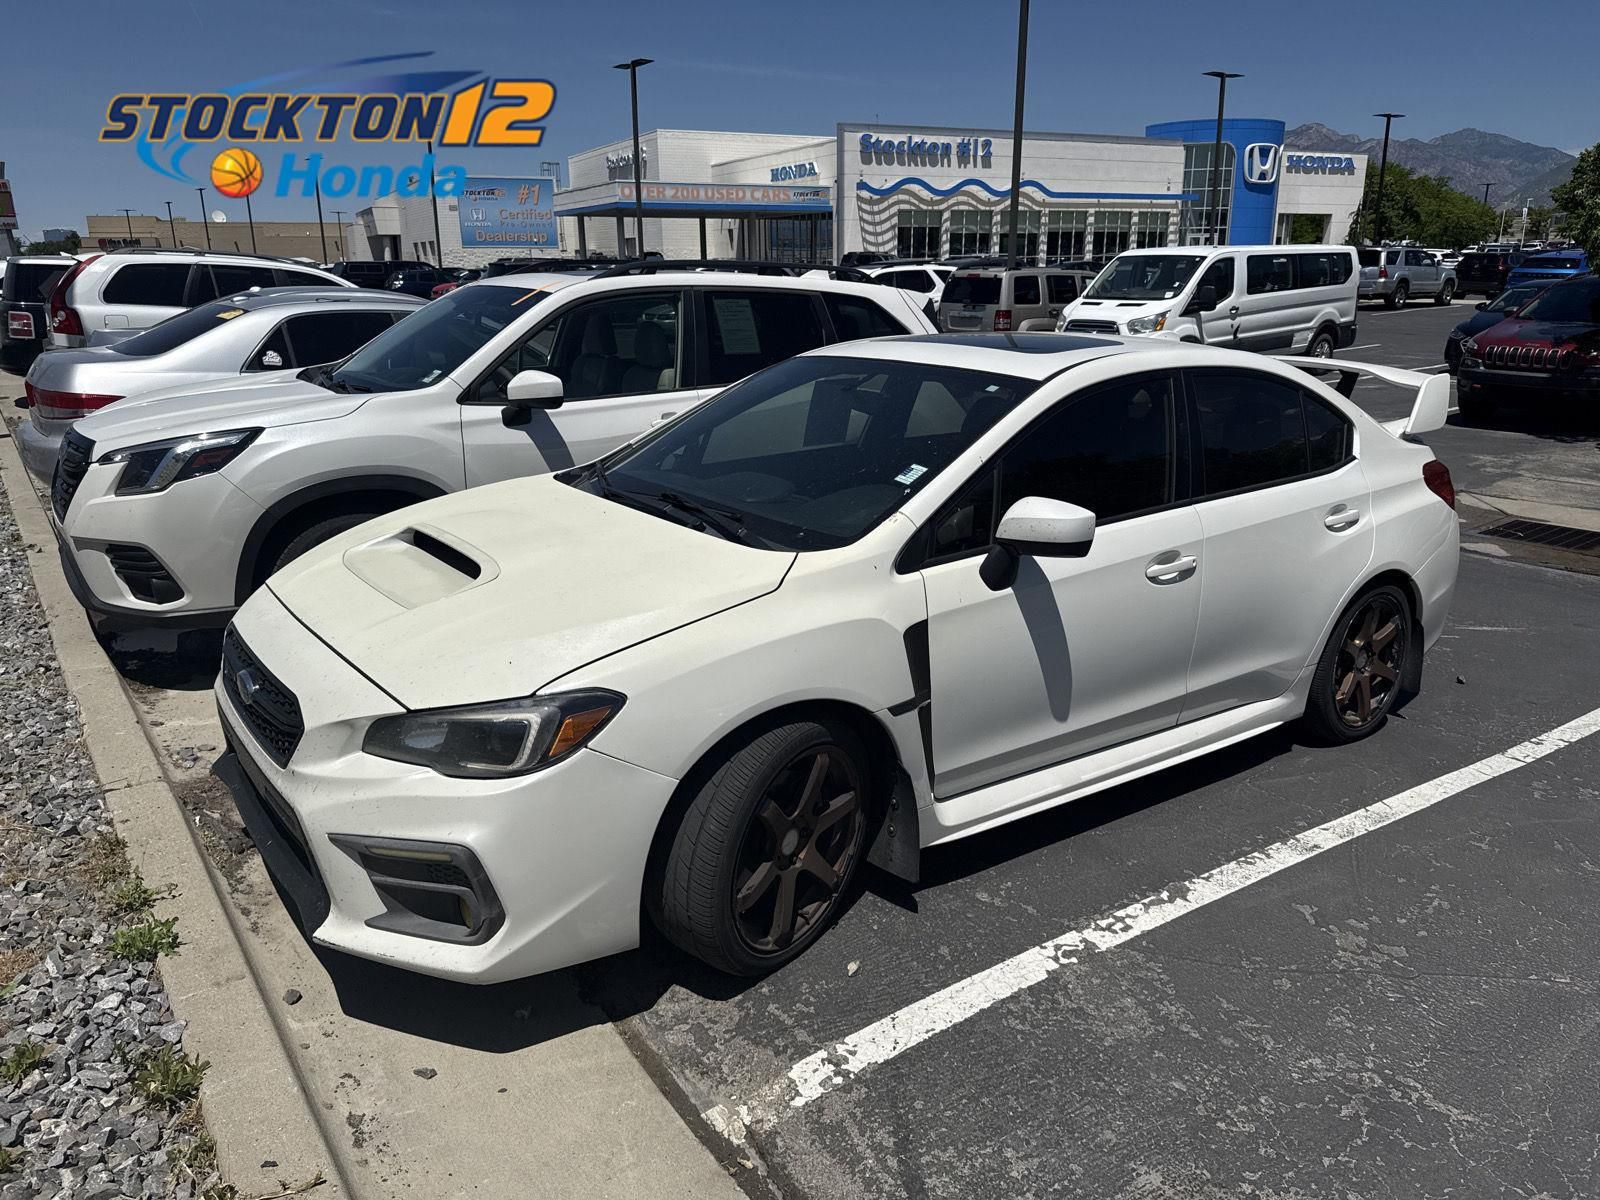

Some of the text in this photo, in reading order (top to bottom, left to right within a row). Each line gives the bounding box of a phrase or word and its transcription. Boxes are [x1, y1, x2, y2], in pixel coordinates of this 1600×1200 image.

[860, 133, 992, 157] Stockton #12
[1287, 154, 1355, 169] HONDA
[770, 161, 818, 182] HONDA
[517, 184, 541, 205] #1
[671, 187, 700, 200] 200
[704, 187, 746, 201] USED
[750, 187, 791, 202] CARS
[500, 208, 552, 220] Certified
[476, 231, 547, 243] Dealership
